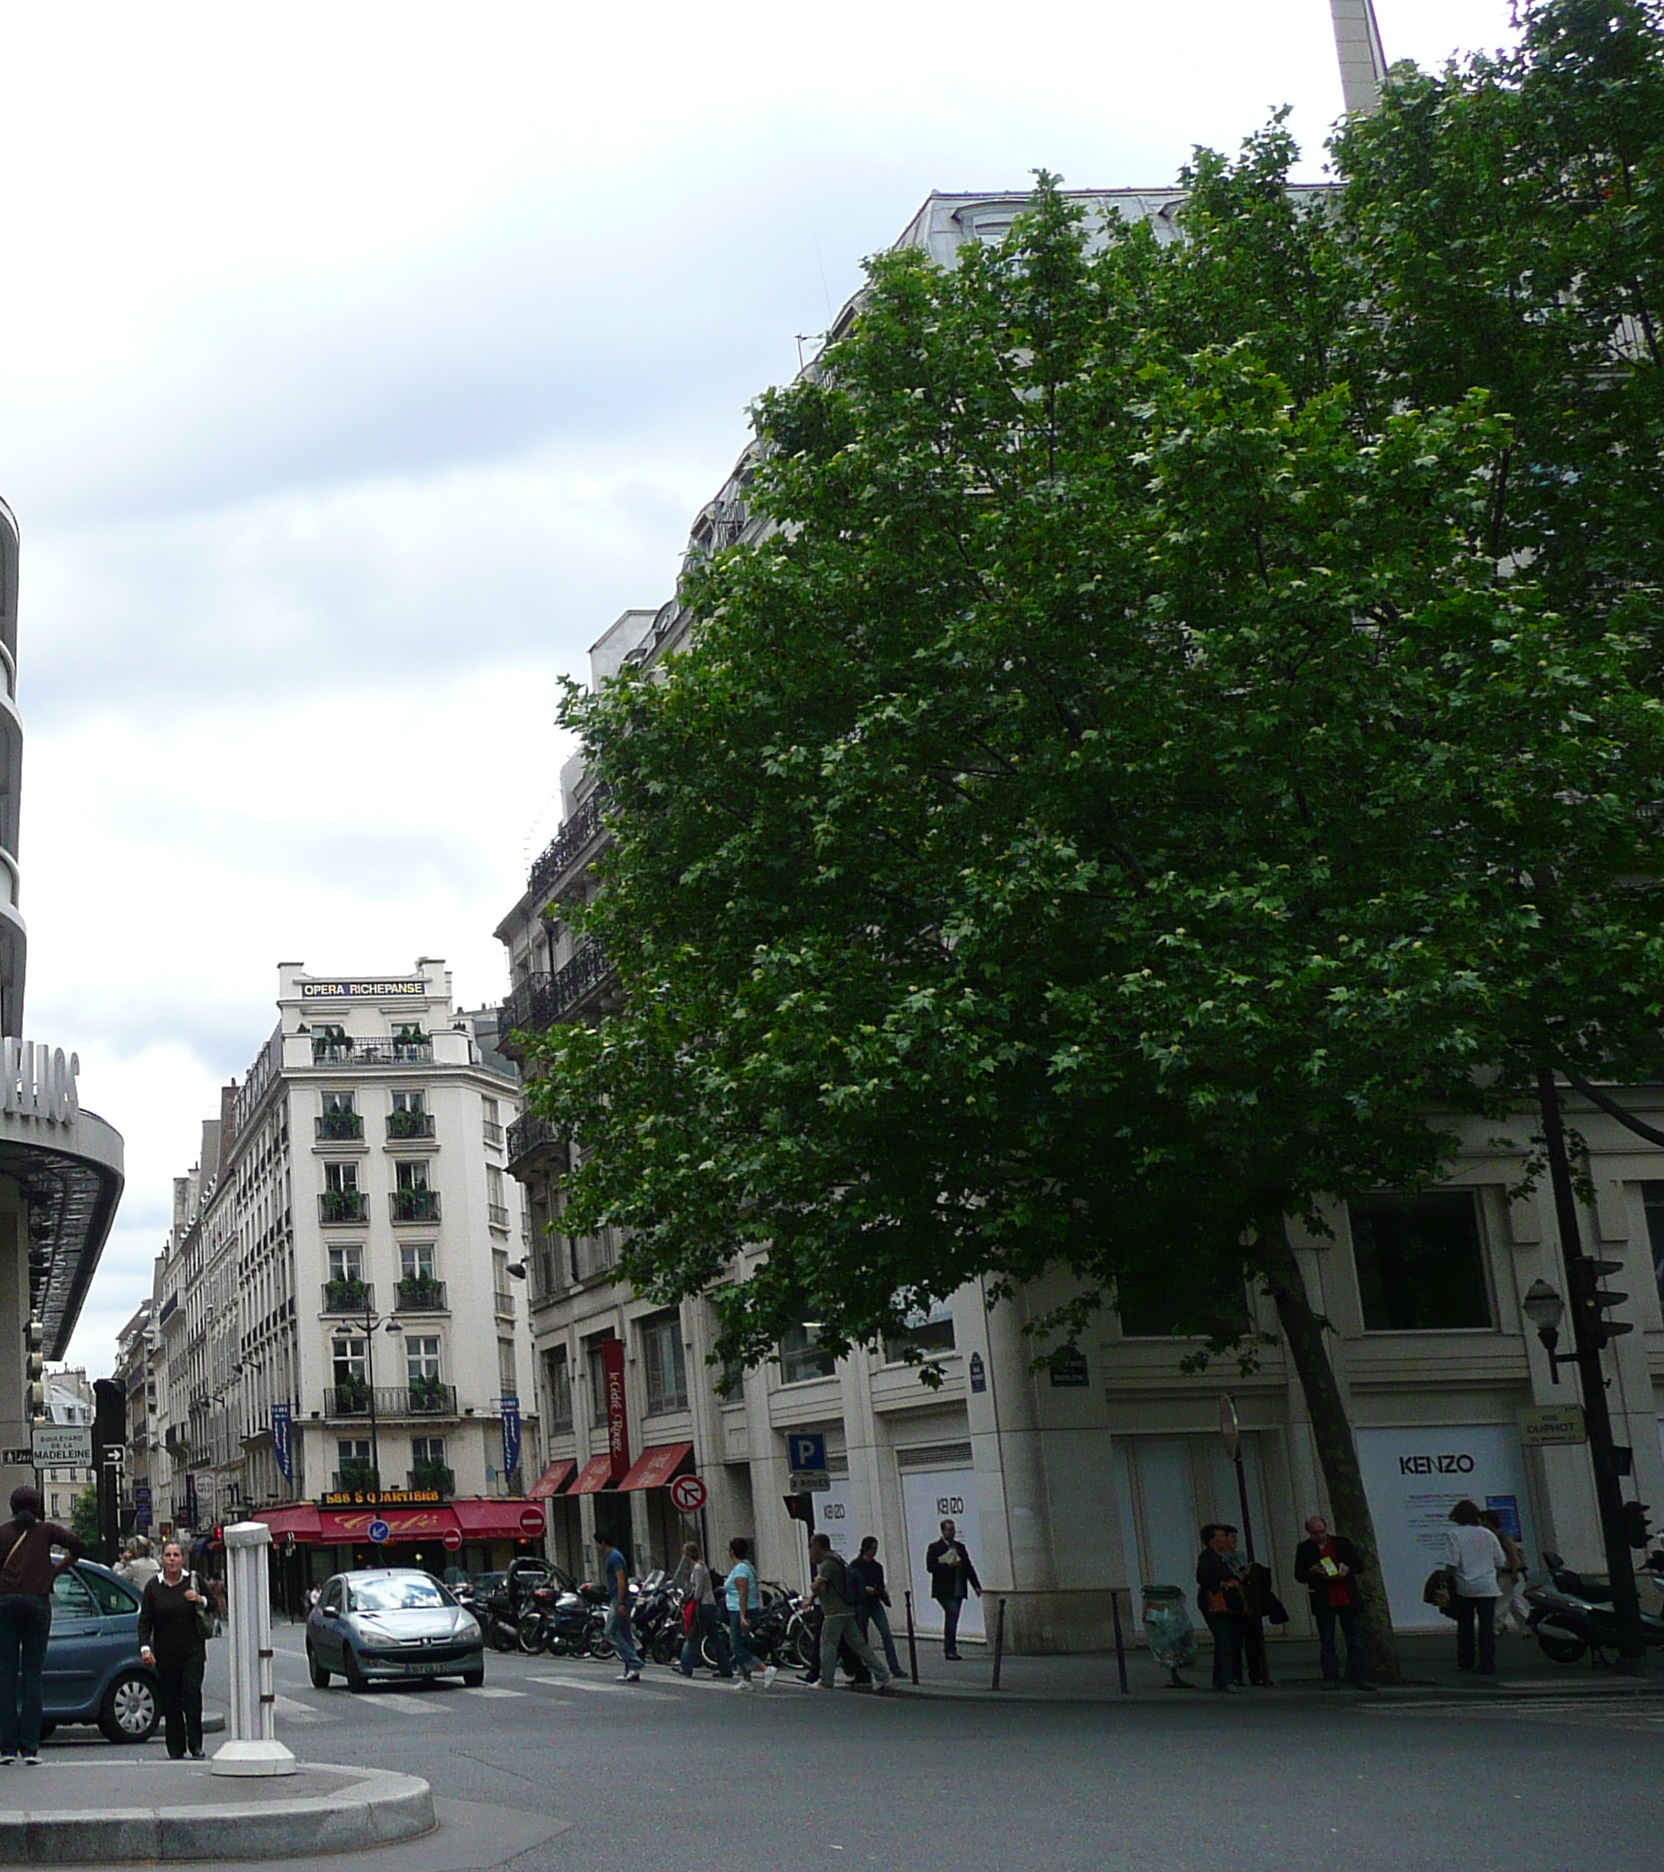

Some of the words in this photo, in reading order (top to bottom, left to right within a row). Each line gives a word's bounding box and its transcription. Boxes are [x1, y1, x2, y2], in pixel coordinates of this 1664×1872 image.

[304, 984, 345, 996] OPERA
[349, 982, 424, 995] RICHEPANSE
[1526, 1422, 1576, 1434] DUPHOT
[40, 1434, 84, 1443] BOULEVARD
[610, 1414, 624, 1459] Rouge
[34, 1449, 91, 1461] MADELEINE
[797, 1439, 816, 1465] P
[1399, 1454, 1475, 1475] KENZO
[800, 1479, 828, 1488] ROUES
[325, 1492, 351, 1505] LES
[823, 1504, 846, 1520] KENZO
[936, 1497, 965, 1515] KENZO
